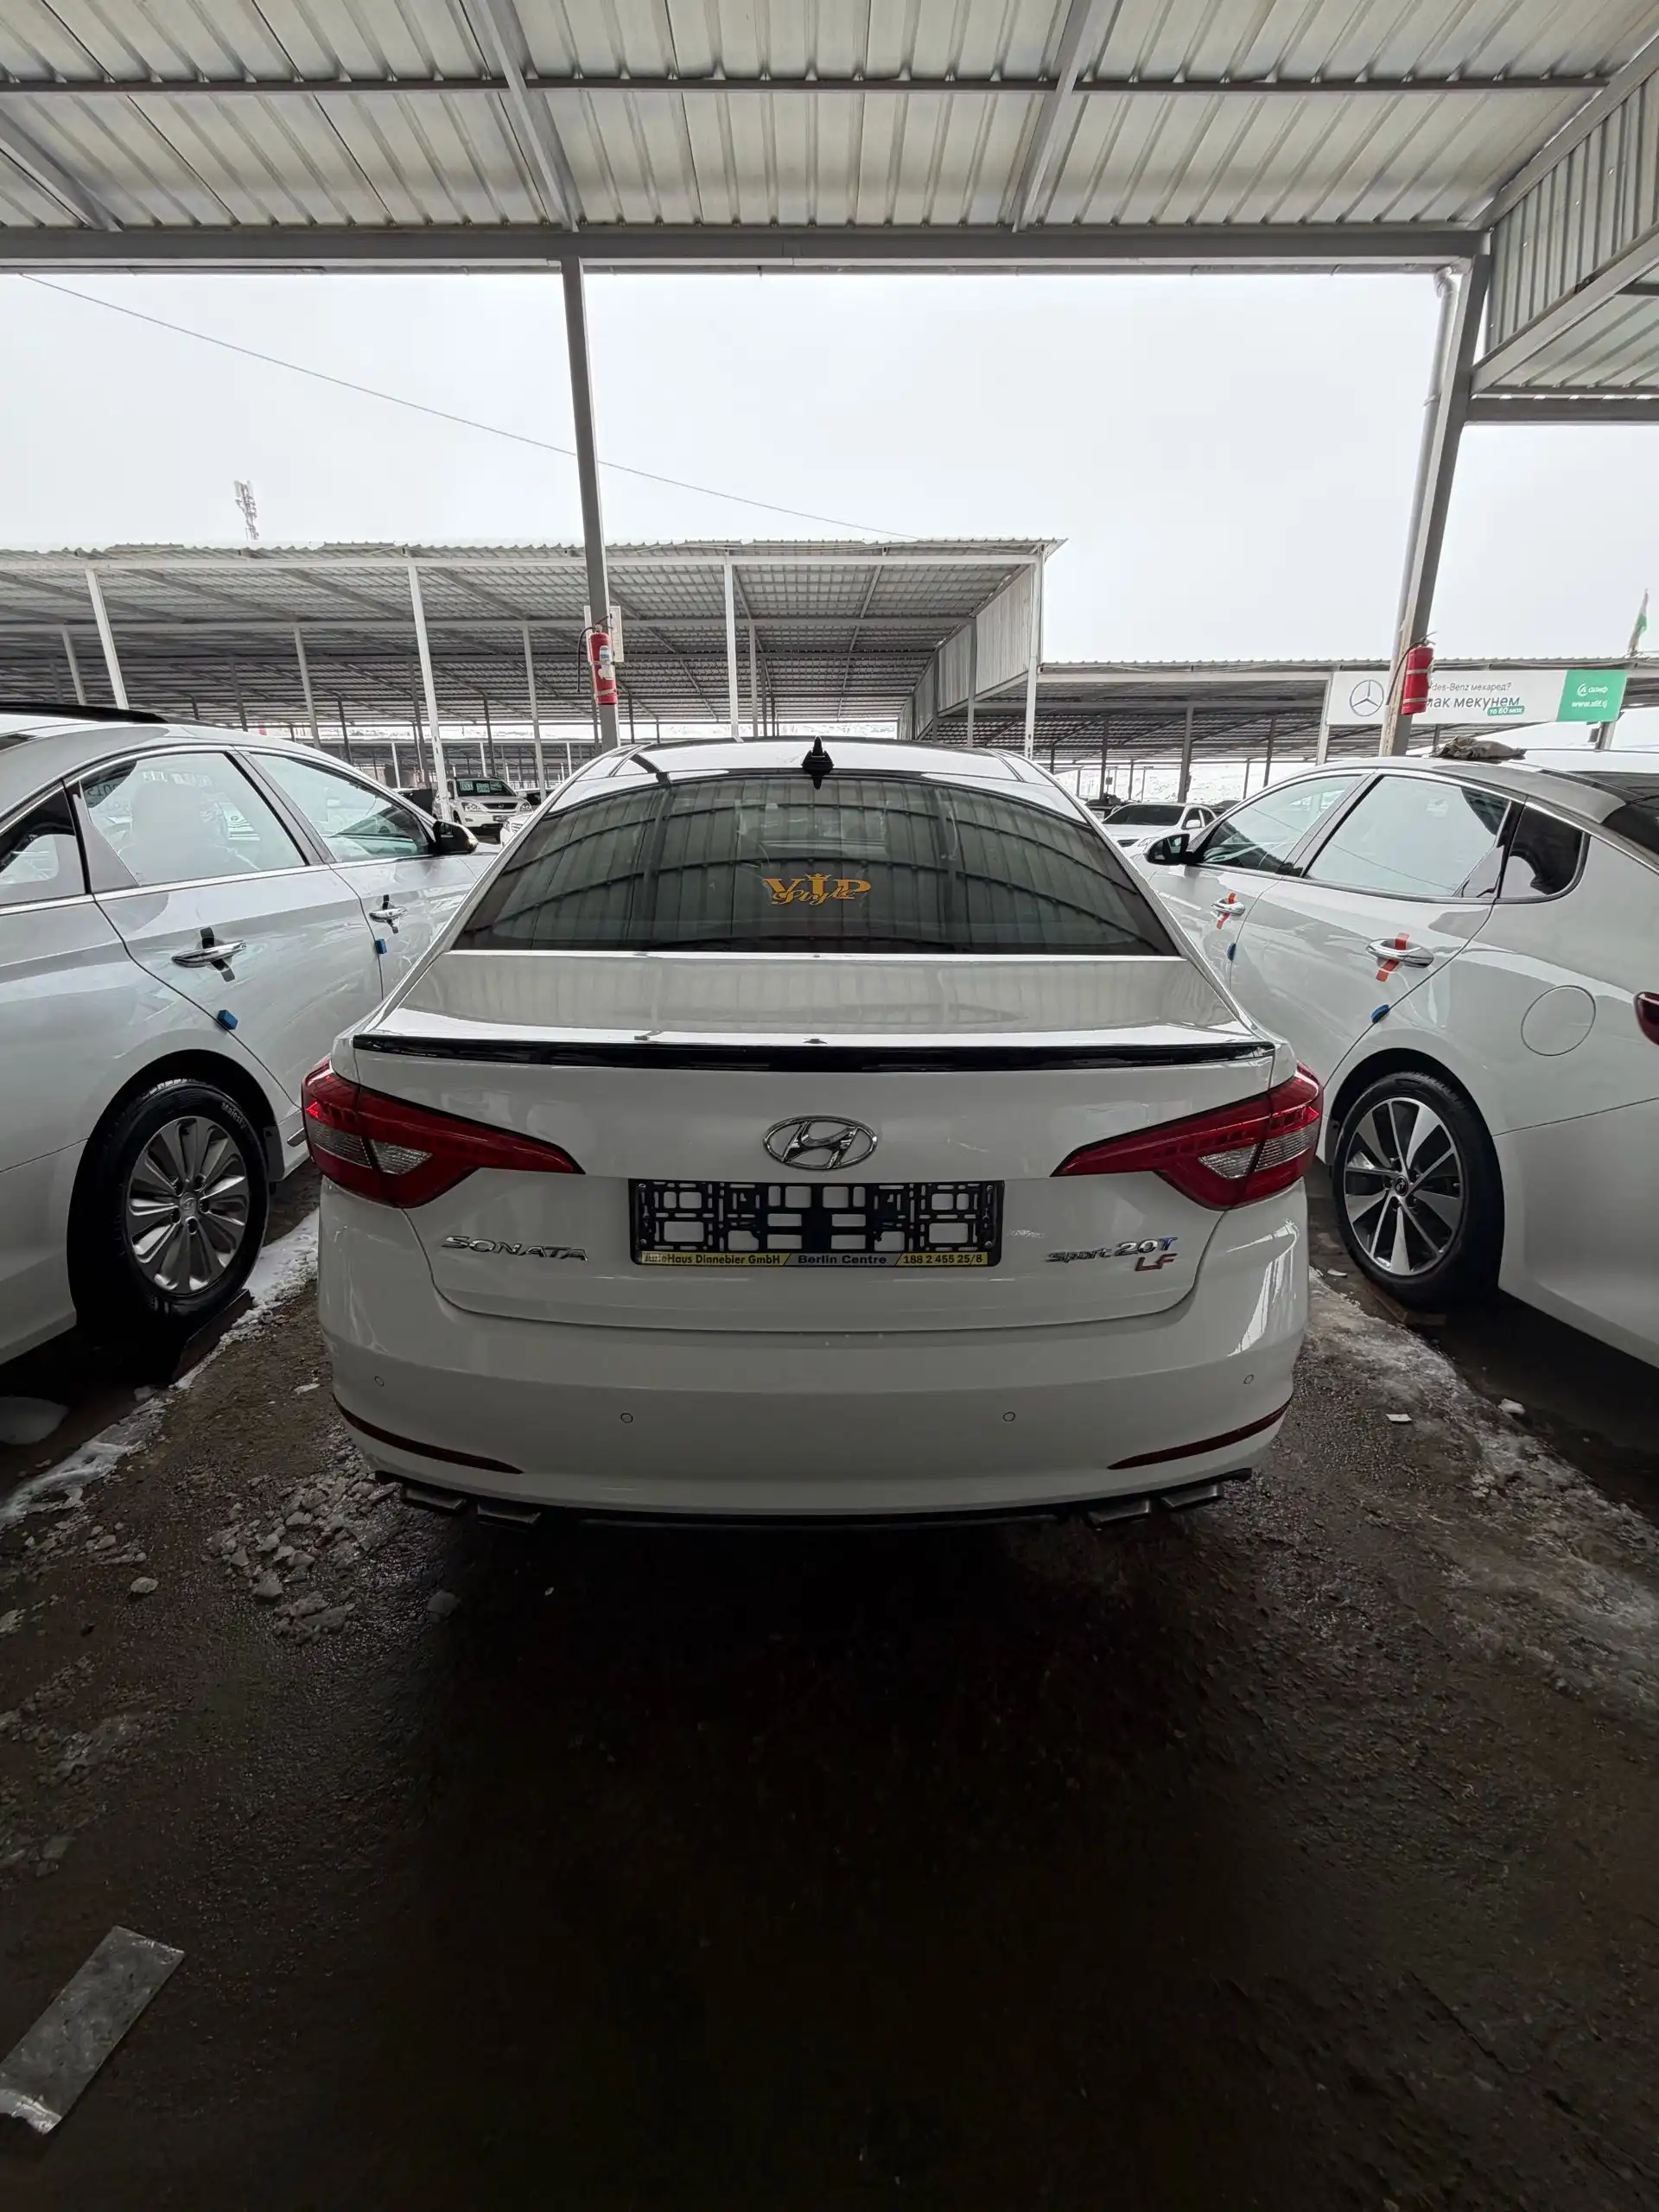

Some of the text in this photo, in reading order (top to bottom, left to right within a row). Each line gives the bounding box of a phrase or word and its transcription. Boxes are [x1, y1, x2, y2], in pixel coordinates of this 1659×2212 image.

[1432, 683, 1470, 691] des-Benz
[1453, 696, 1520, 711] мекунем
[762, 876, 871, 899] VIP
[442, 1236, 588, 1262] SONATA
[696, 1254, 745, 1264] Dinnebier
[747, 1255, 780, 1264] GmbH
[798, 1255, 837, 1264] Berlin
[842, 1255, 887, 1264] Centre
[903, 1255, 923, 1264] 188
[925, 1255, 933, 1263] 2
[957, 1254, 982, 1263] 25/8
